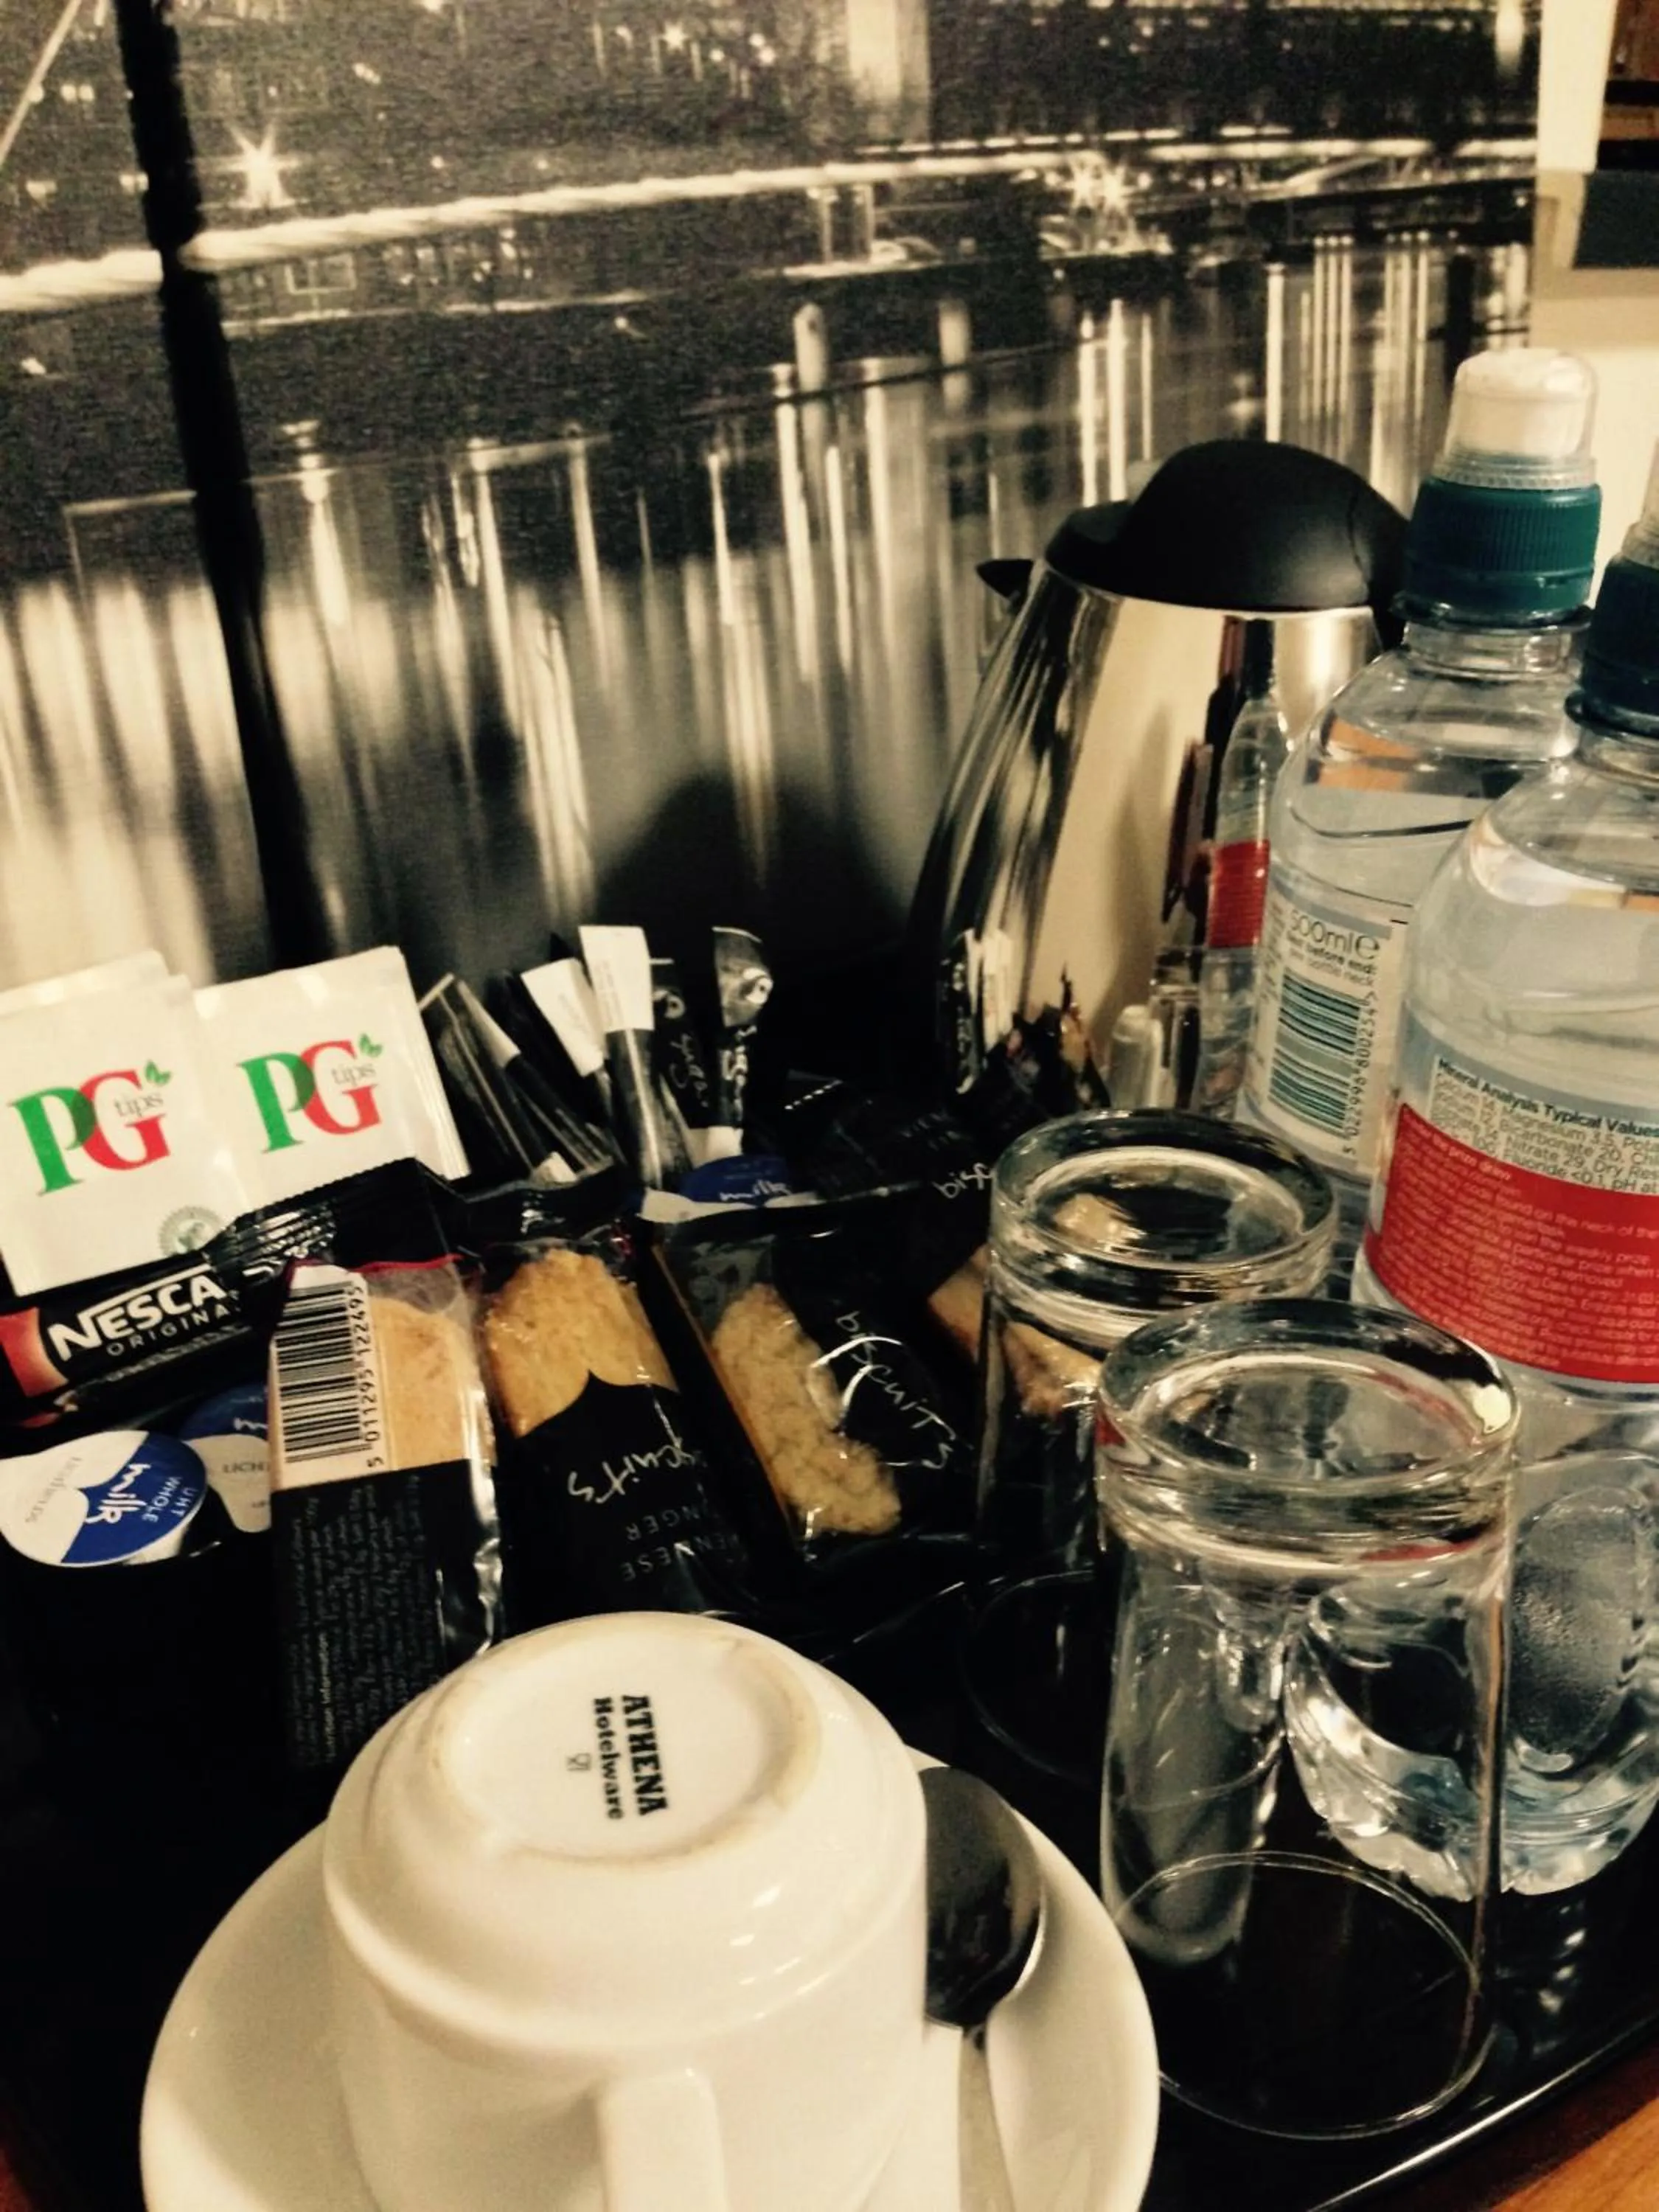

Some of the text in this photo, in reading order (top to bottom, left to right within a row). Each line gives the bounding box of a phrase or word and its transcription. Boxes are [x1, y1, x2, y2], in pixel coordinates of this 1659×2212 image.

[113, 1090, 165, 1123] tips
[237, 1038, 382, 1154] PG
[329, 1056, 378, 1091] tips
[10, 1066, 171, 1197] PG
[1544, 1103, 1603, 1130] Typical
[46, 1262, 234, 1363] NESCA
[105, 1303, 234, 1357] ORIGINA
[347, 1285, 371, 1354] 122495
[358, 1366, 381, 1444] 011295
[85, 1461, 153, 1526] milk
[146, 1475, 184, 1524] WHOLE
[566, 1437, 700, 1505] scuits
[593, 1697, 625, 1820] Hotelware
[621, 1694, 669, 1816] ATHENA
